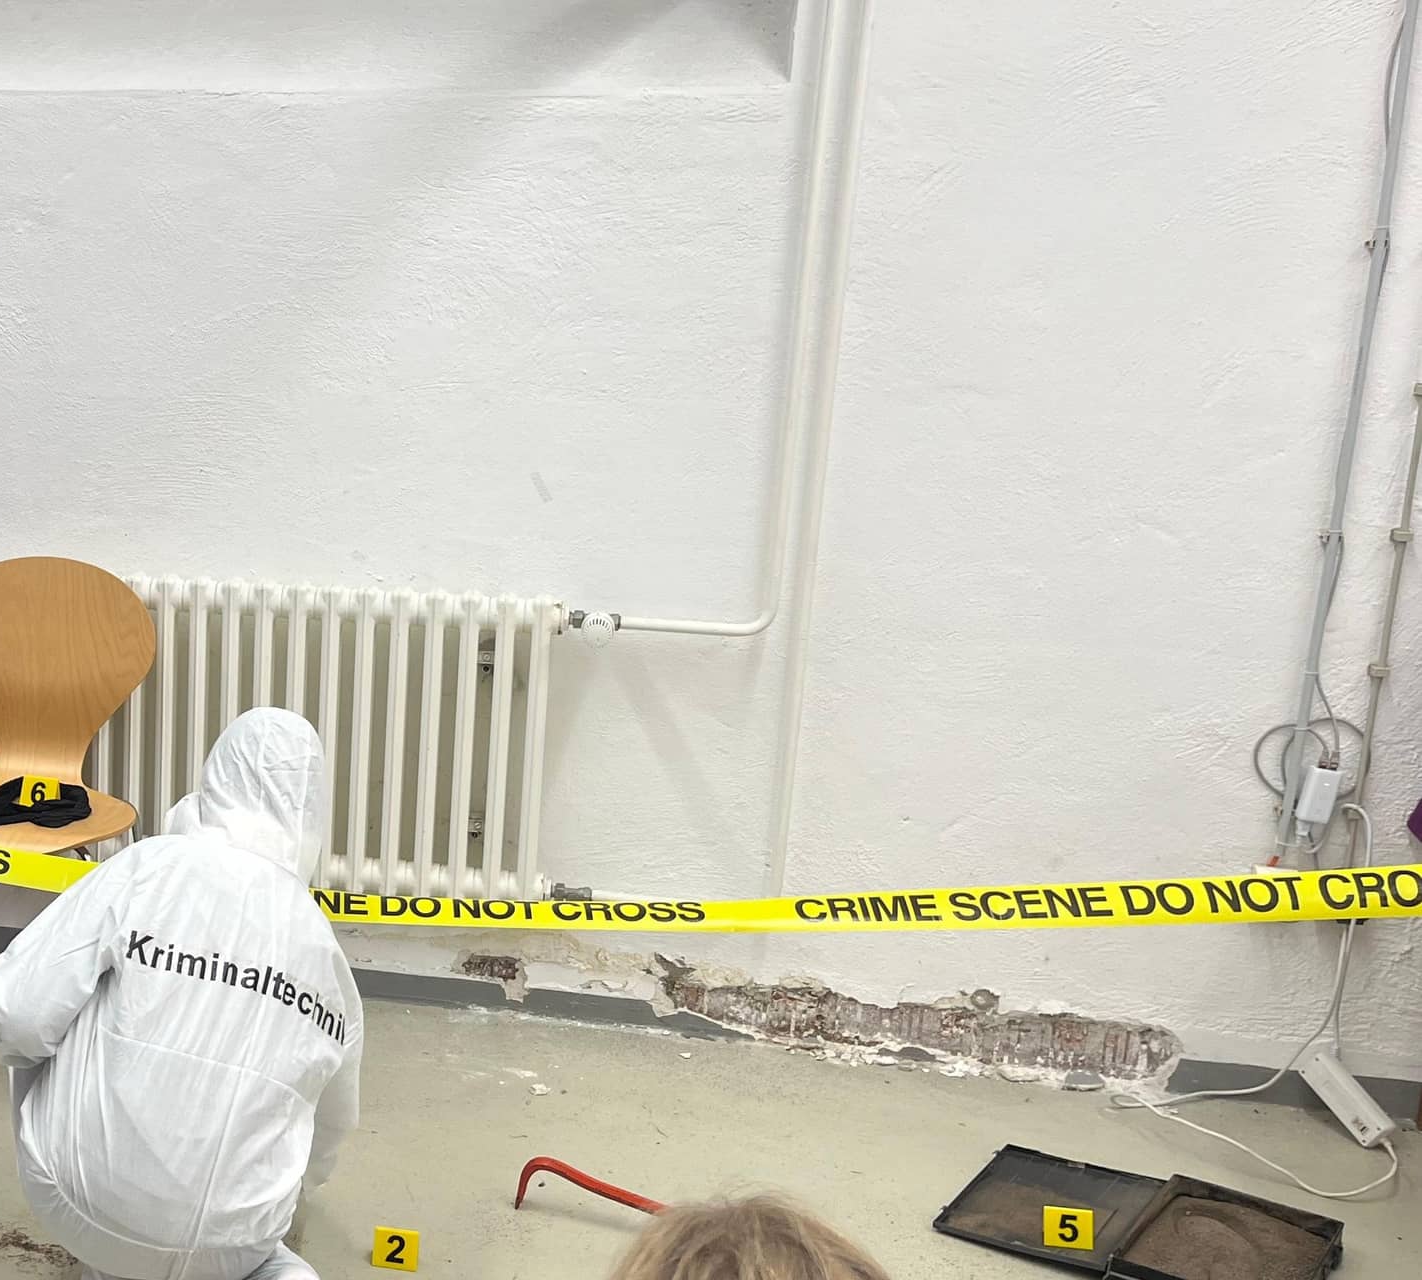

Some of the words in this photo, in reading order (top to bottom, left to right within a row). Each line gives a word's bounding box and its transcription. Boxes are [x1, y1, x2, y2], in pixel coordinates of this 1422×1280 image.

[31, 781, 46, 803] 6
[380, 896, 440, 917] DO
[453, 899, 539, 919] NOT
[552, 901, 706, 923] CROSS
[794, 895, 942, 921] CRIME
[948, 887, 1114, 921] SCENE
[1119, 882, 1195, 916] DO
[1202, 876, 1302, 913] NOT
[1318, 870, 1422, 910] CRO
[1058, 1214, 1078, 1242] 5
[385, 1235, 405, 1264] 2
